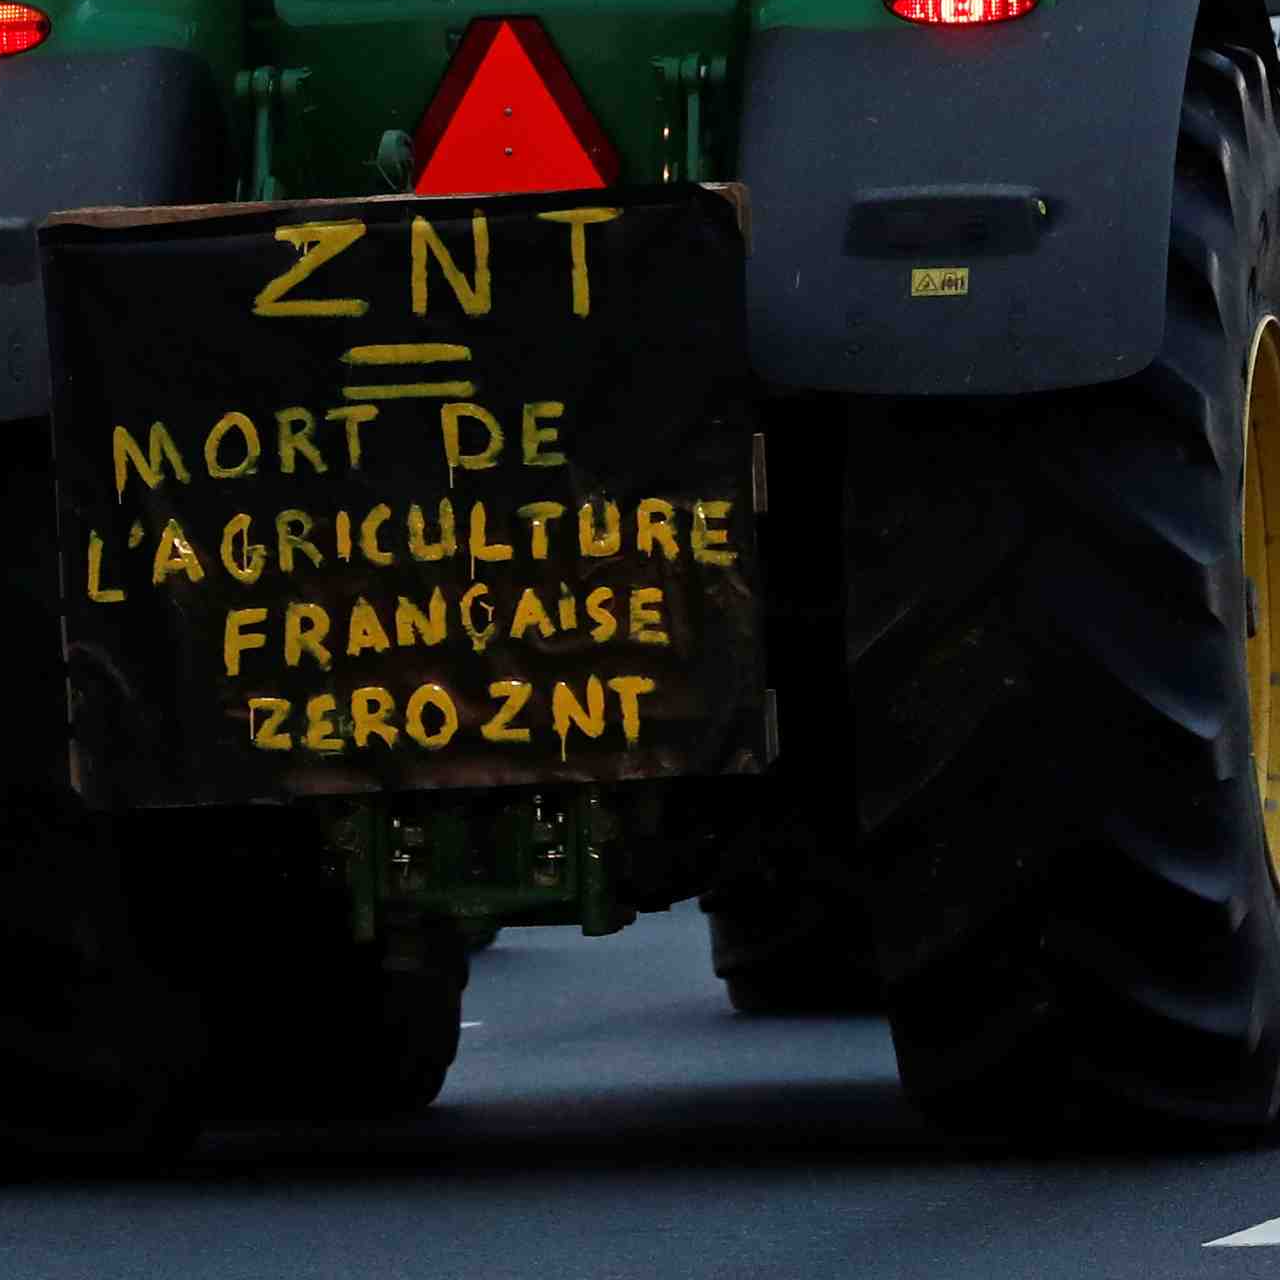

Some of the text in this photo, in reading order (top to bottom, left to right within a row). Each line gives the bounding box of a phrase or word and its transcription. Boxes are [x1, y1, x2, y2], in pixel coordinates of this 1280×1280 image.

[112, 401, 566, 502] MORT DE
[86, 498, 738, 603] L'AGRICULTURE
[224, 583, 669, 675] FRANÇAISE
[248, 673, 656, 760] ZERO ZNT
